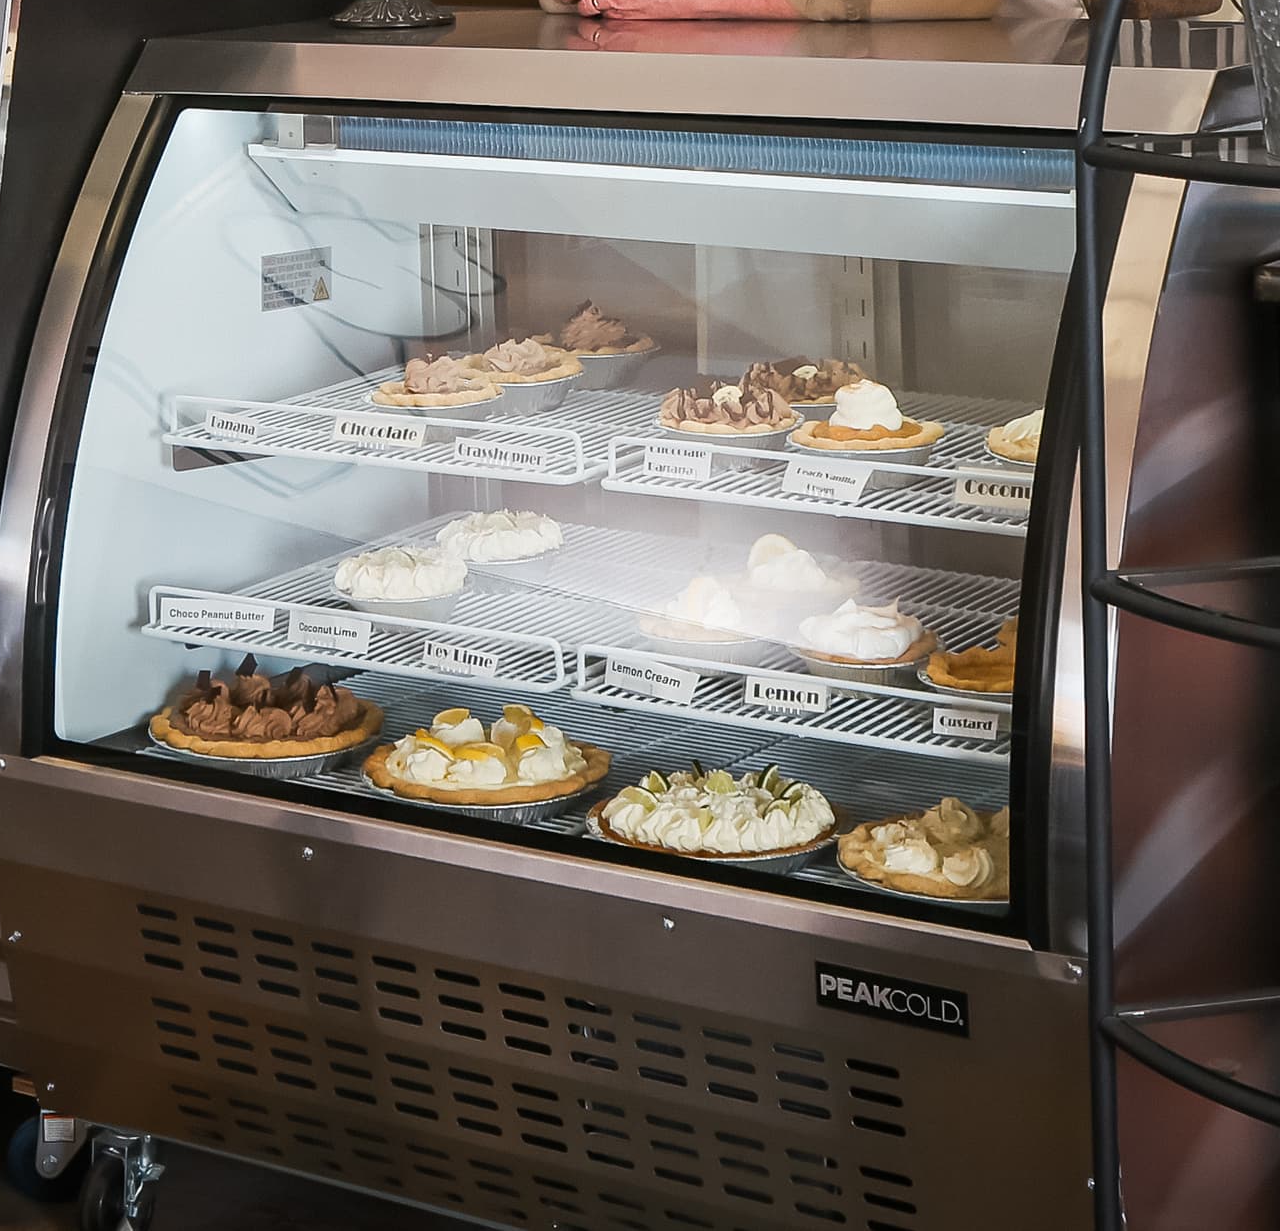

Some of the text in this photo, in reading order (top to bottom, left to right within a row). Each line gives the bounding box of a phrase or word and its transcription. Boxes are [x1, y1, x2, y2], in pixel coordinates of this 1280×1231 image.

[210, 415, 256, 436] Banana
[341, 421, 418, 442] Chocolate
[458, 442, 543, 467] Grasshopper
[965, 479, 1031, 500] Coconu
[170, 609, 265, 621] Choco Peanut Butter
[298, 622, 358, 638] Coconut Lime
[454, 648, 494, 668] Lime
[612, 661, 681, 688] Lemon Cream
[753, 683, 819, 705] Lemon
[939, 716, 993, 731] Custard
